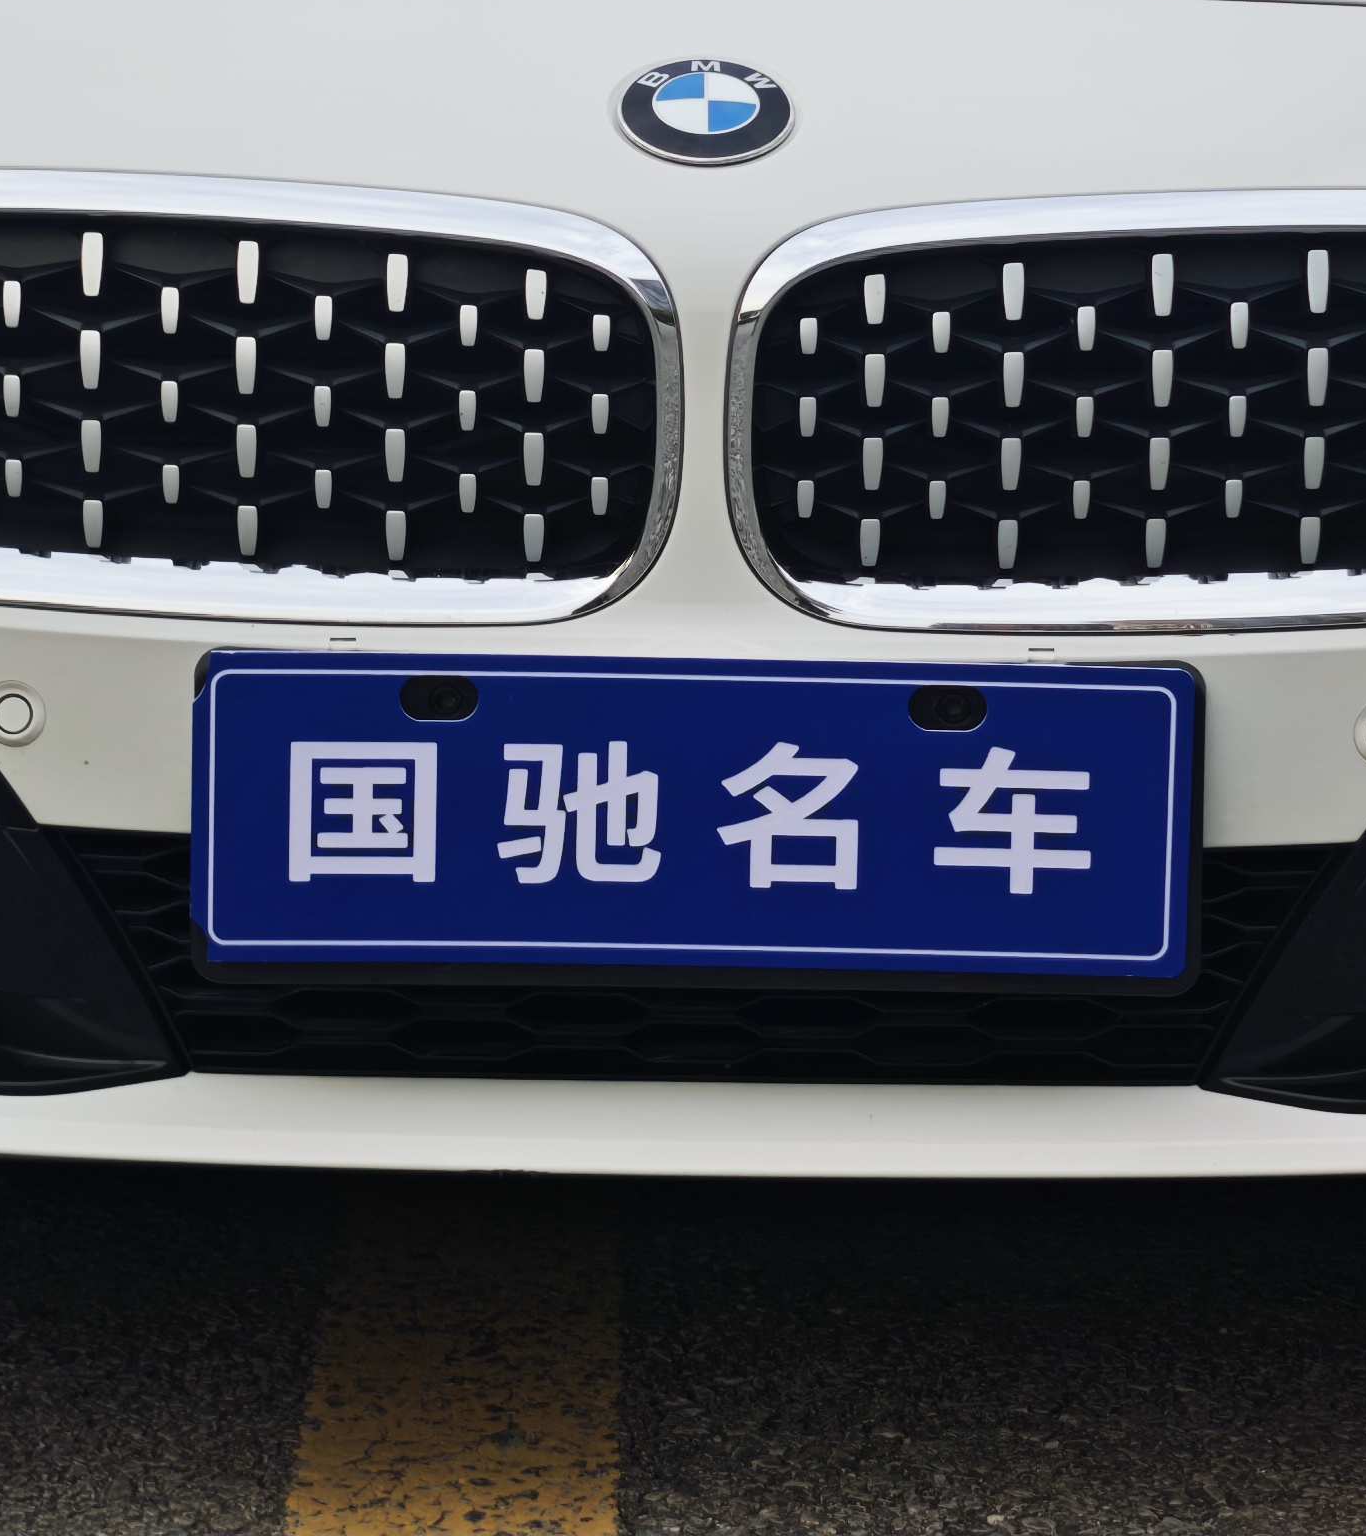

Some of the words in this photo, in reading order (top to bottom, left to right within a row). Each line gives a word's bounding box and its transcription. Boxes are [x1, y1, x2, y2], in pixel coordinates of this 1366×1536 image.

[636, 60, 778, 89] BMW
[288, 741, 1093, 895] 国驰名车
